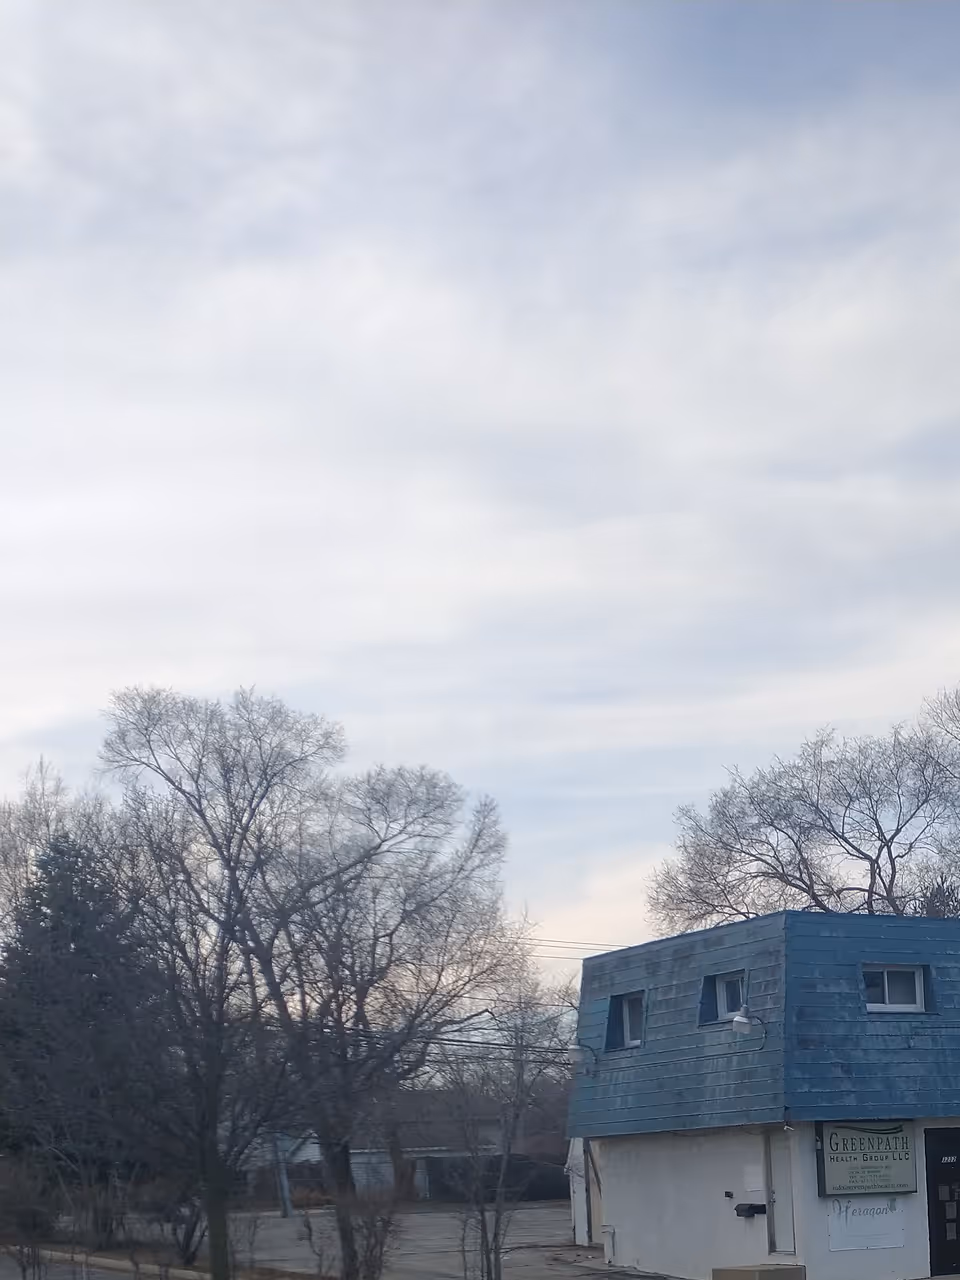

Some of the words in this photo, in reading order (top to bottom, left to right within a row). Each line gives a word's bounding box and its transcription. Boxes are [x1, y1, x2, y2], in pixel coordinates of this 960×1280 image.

[829, 1132, 909, 1151] GREENPATH
[862, 1153, 889, 1161] GROUP
[892, 1152, 910, 1161] LLC
